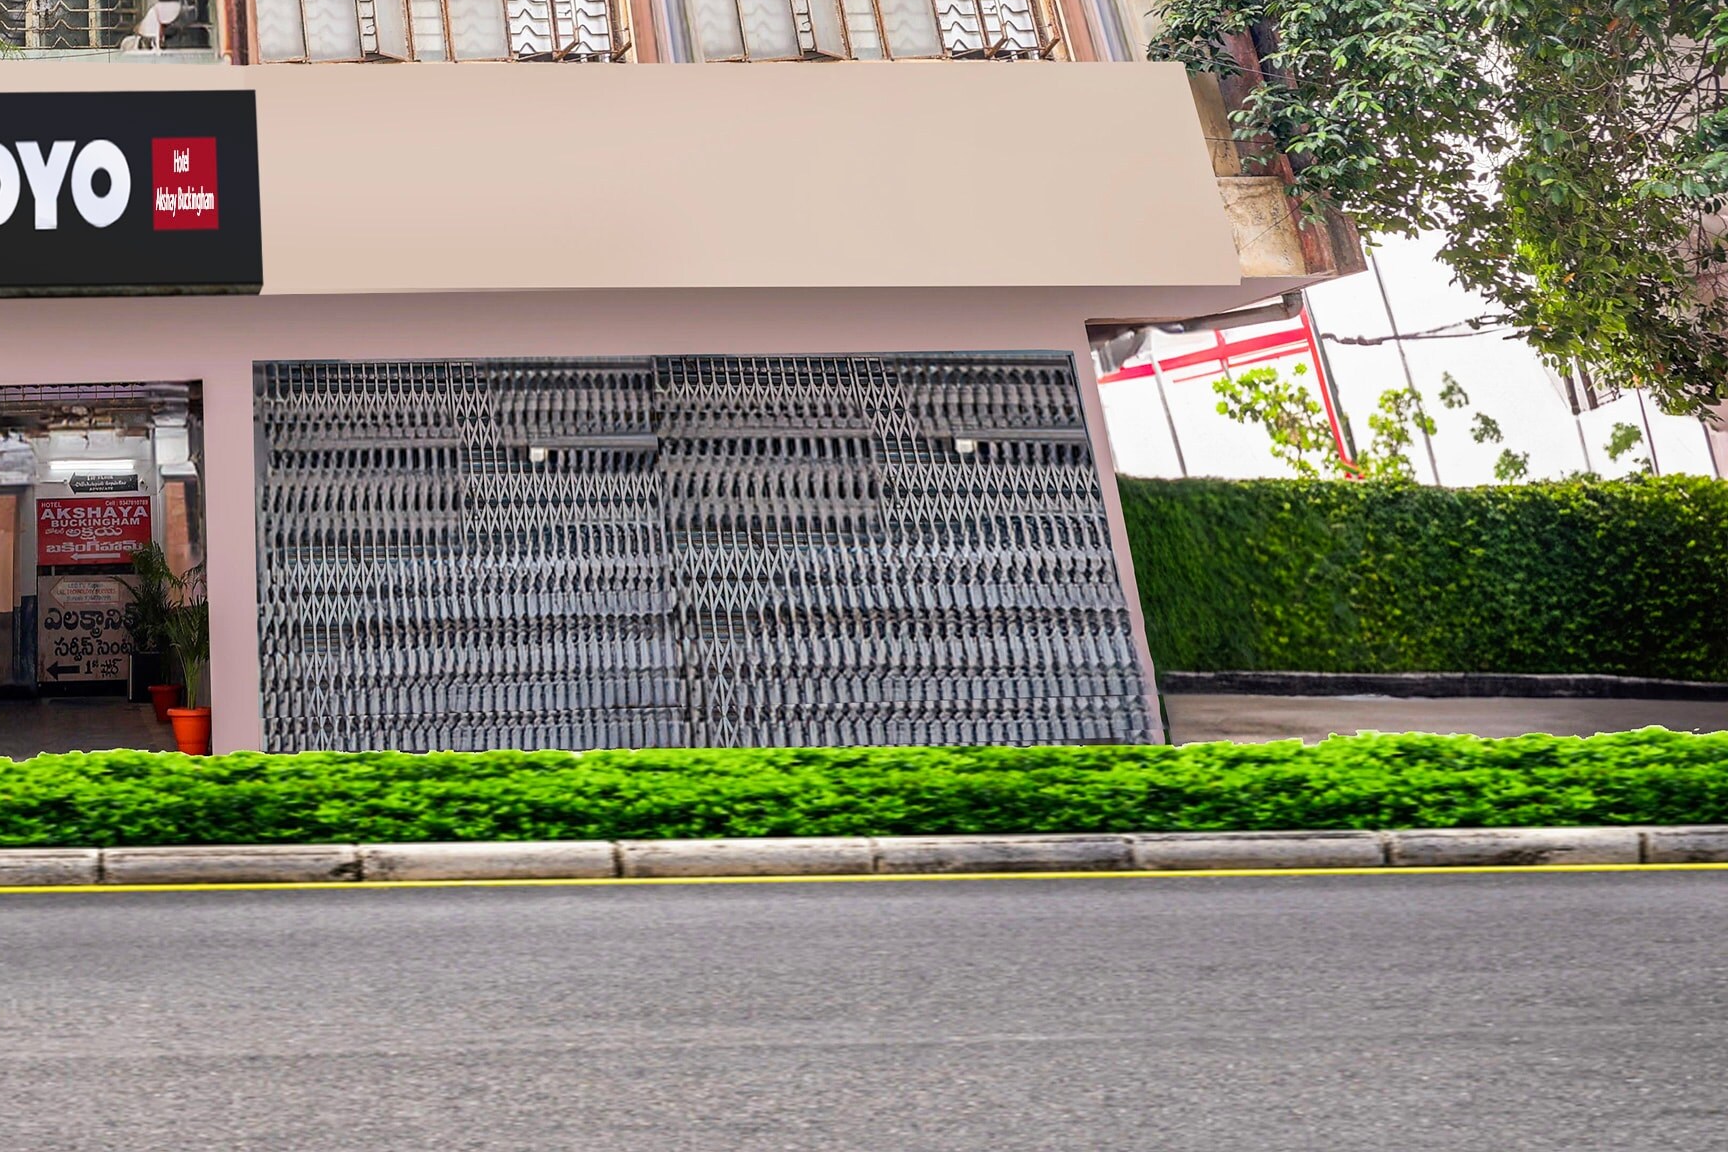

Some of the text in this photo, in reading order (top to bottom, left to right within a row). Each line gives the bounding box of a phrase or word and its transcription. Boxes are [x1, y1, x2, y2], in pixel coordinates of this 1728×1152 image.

[173, 148, 190, 173] Hotel
[156, 186, 214, 217] Akshay Buckingham
[41, 506, 148, 520] AKSHAYA
[51, 517, 140, 527] BUCKINGHAM
[65, 526, 123, 540] అక్షయ
